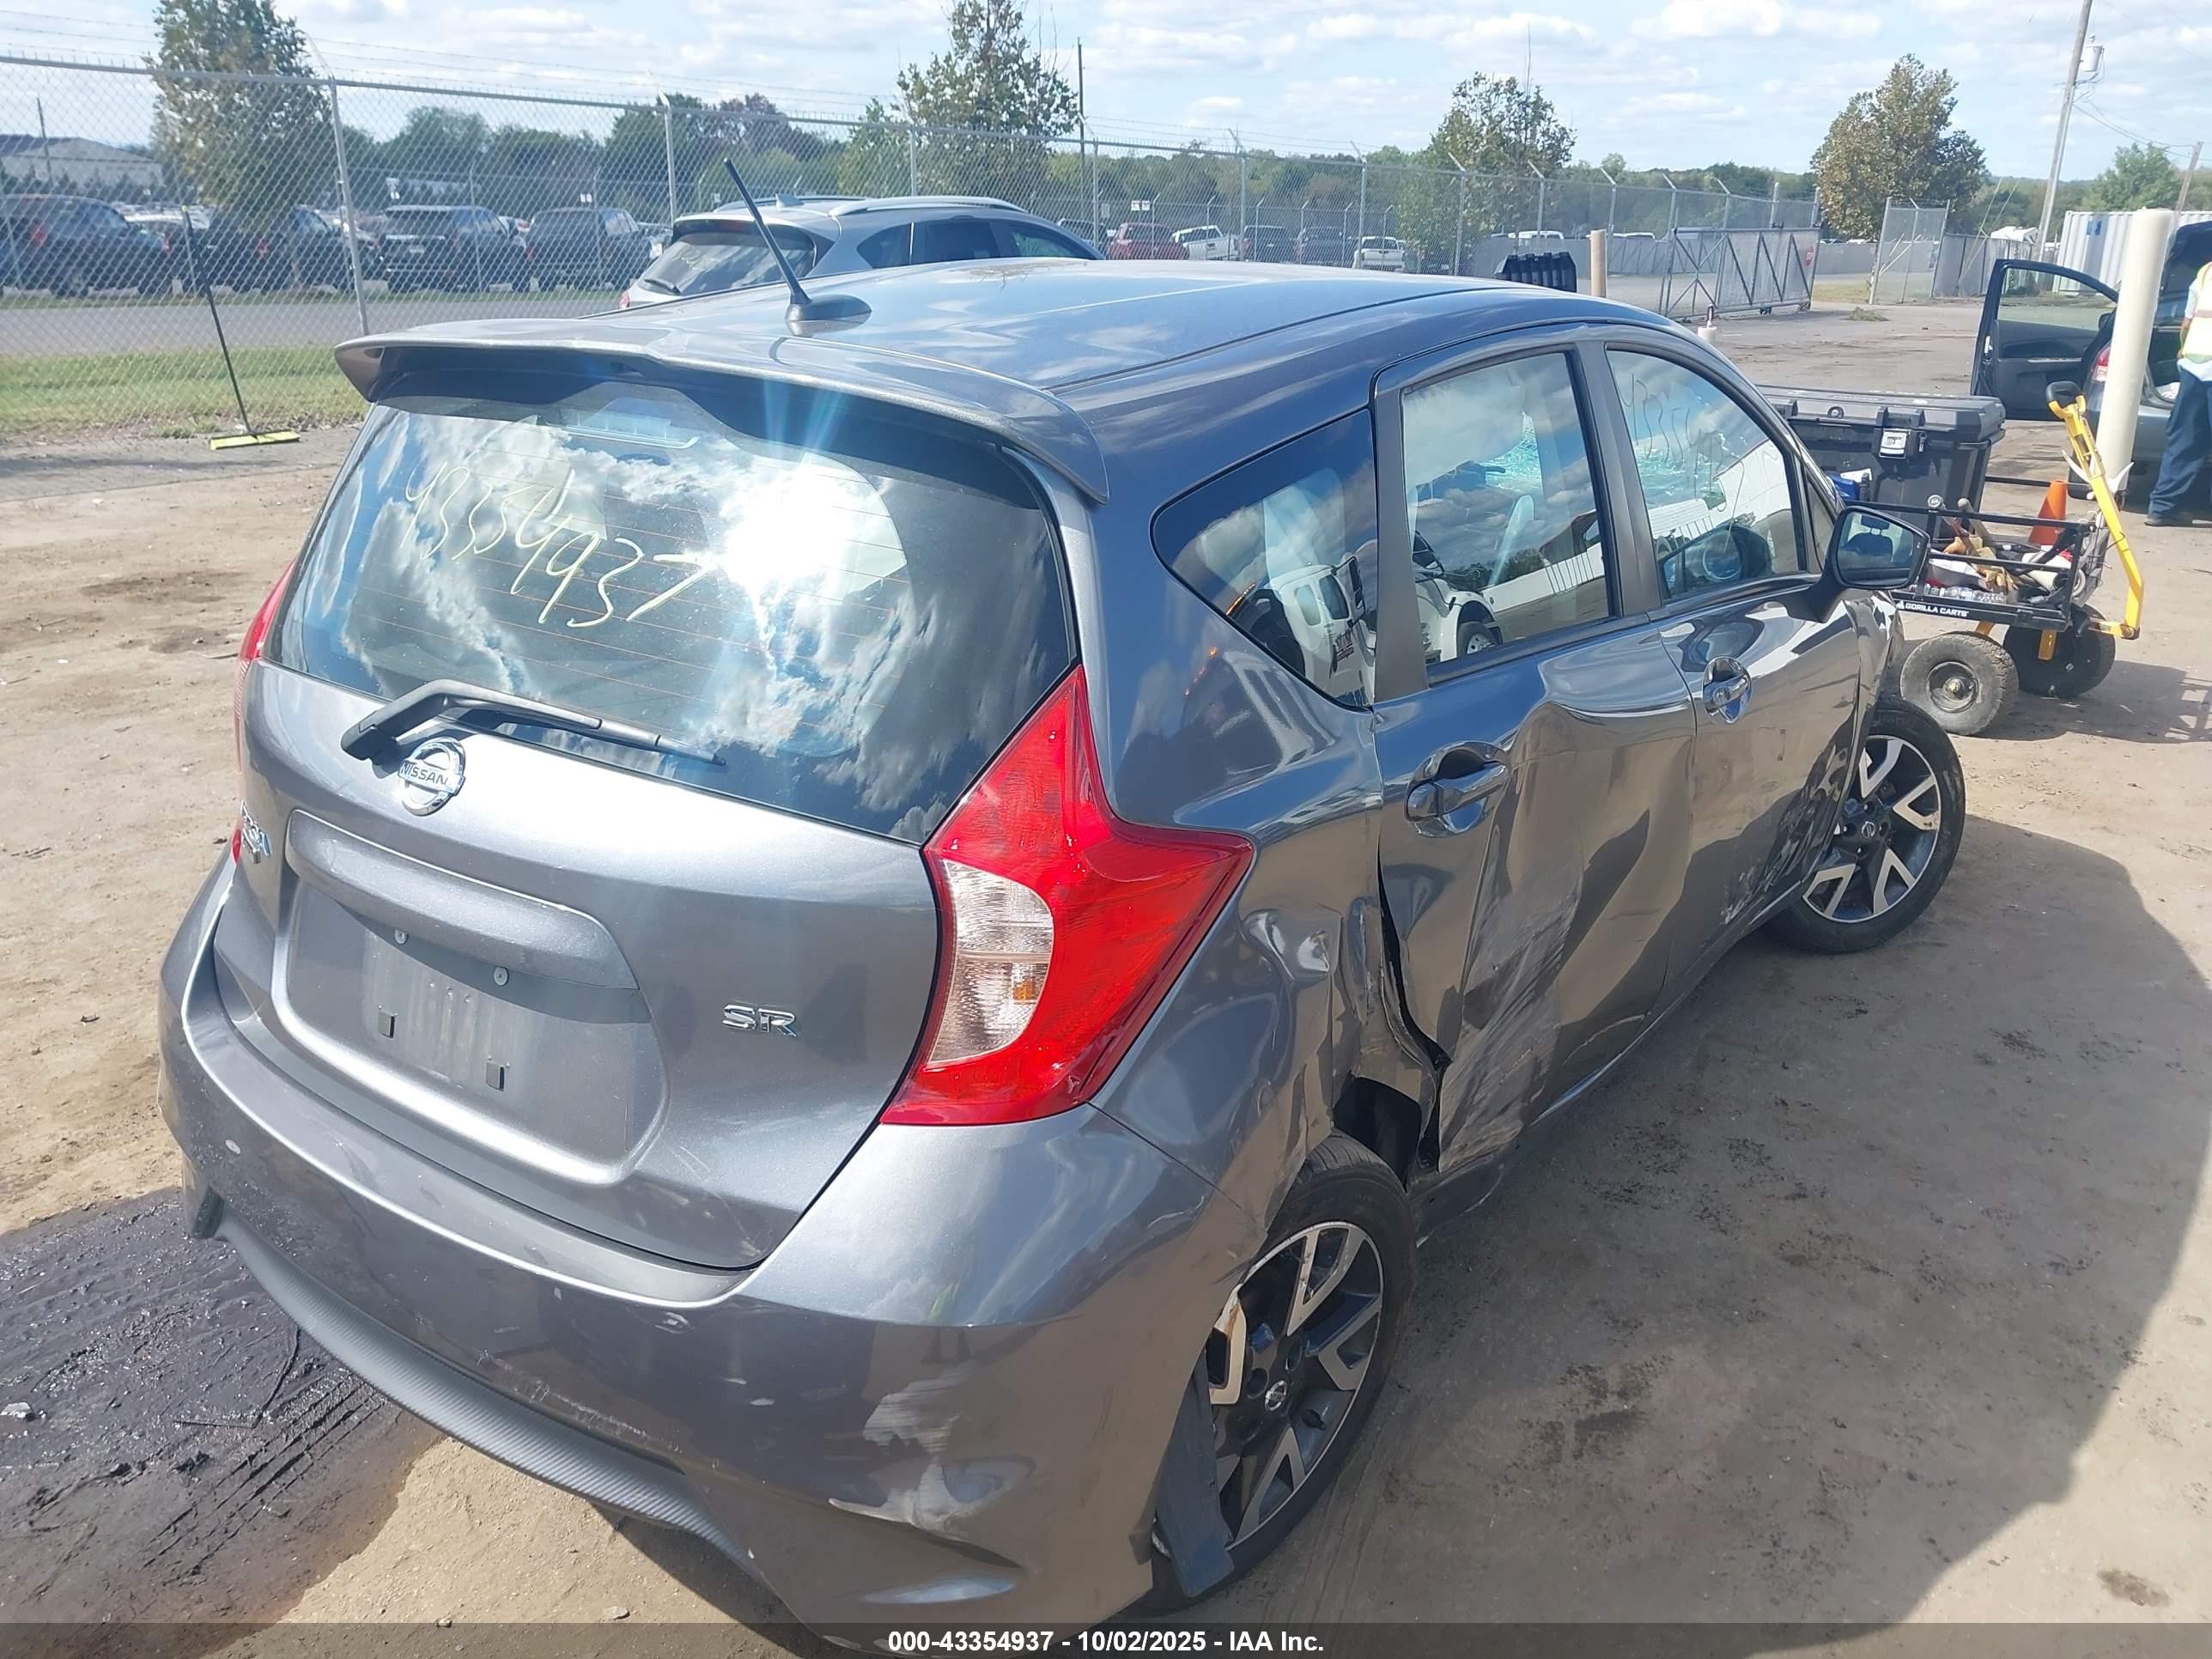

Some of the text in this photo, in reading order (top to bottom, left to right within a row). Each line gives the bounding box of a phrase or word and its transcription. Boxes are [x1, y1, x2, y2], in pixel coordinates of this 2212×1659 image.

[400, 458, 719, 628] 43354937
[1905, 603, 1939, 613] GORILLA
[400, 761, 449, 786] NISSAN
[722, 1003, 798, 1037] SR
